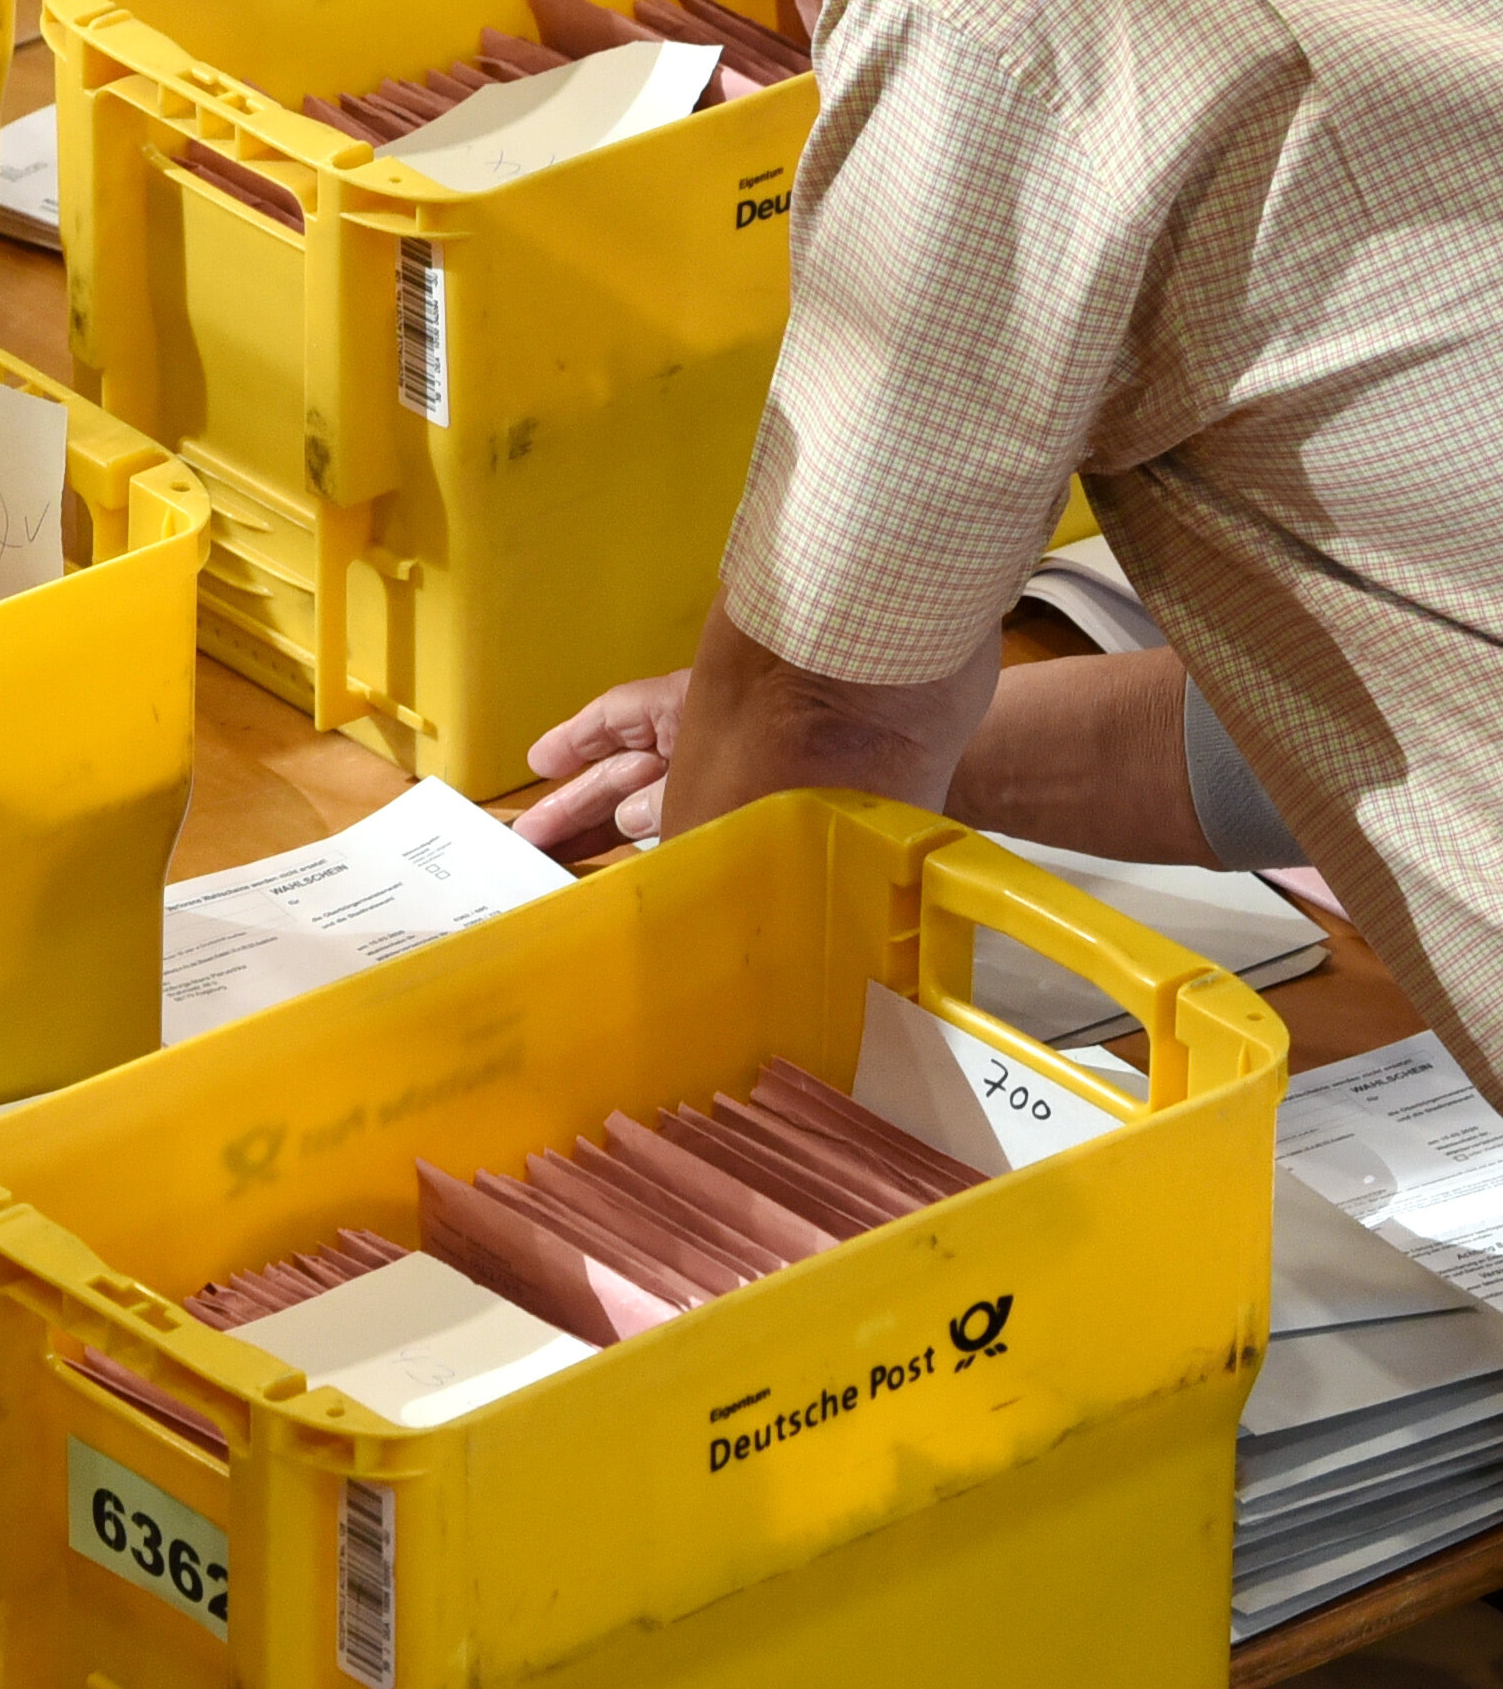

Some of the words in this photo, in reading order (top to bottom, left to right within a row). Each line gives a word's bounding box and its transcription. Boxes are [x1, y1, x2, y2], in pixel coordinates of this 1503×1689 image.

[737, 167, 784, 190] Eigentum
[270, 863, 348, 896] WAHLSCHEIN
[983, 1057, 1051, 1121] 700
[1352, 1062, 1434, 1095] WAHLSCHEIN
[1456, 1243, 1496, 1261] Achtung
[709, 1386, 772, 1424] Eigentum
[709, 1386, 858, 1474] Deutsche
[869, 1345, 935, 1400] Post
[92, 1488, 229, 1623] 6362
